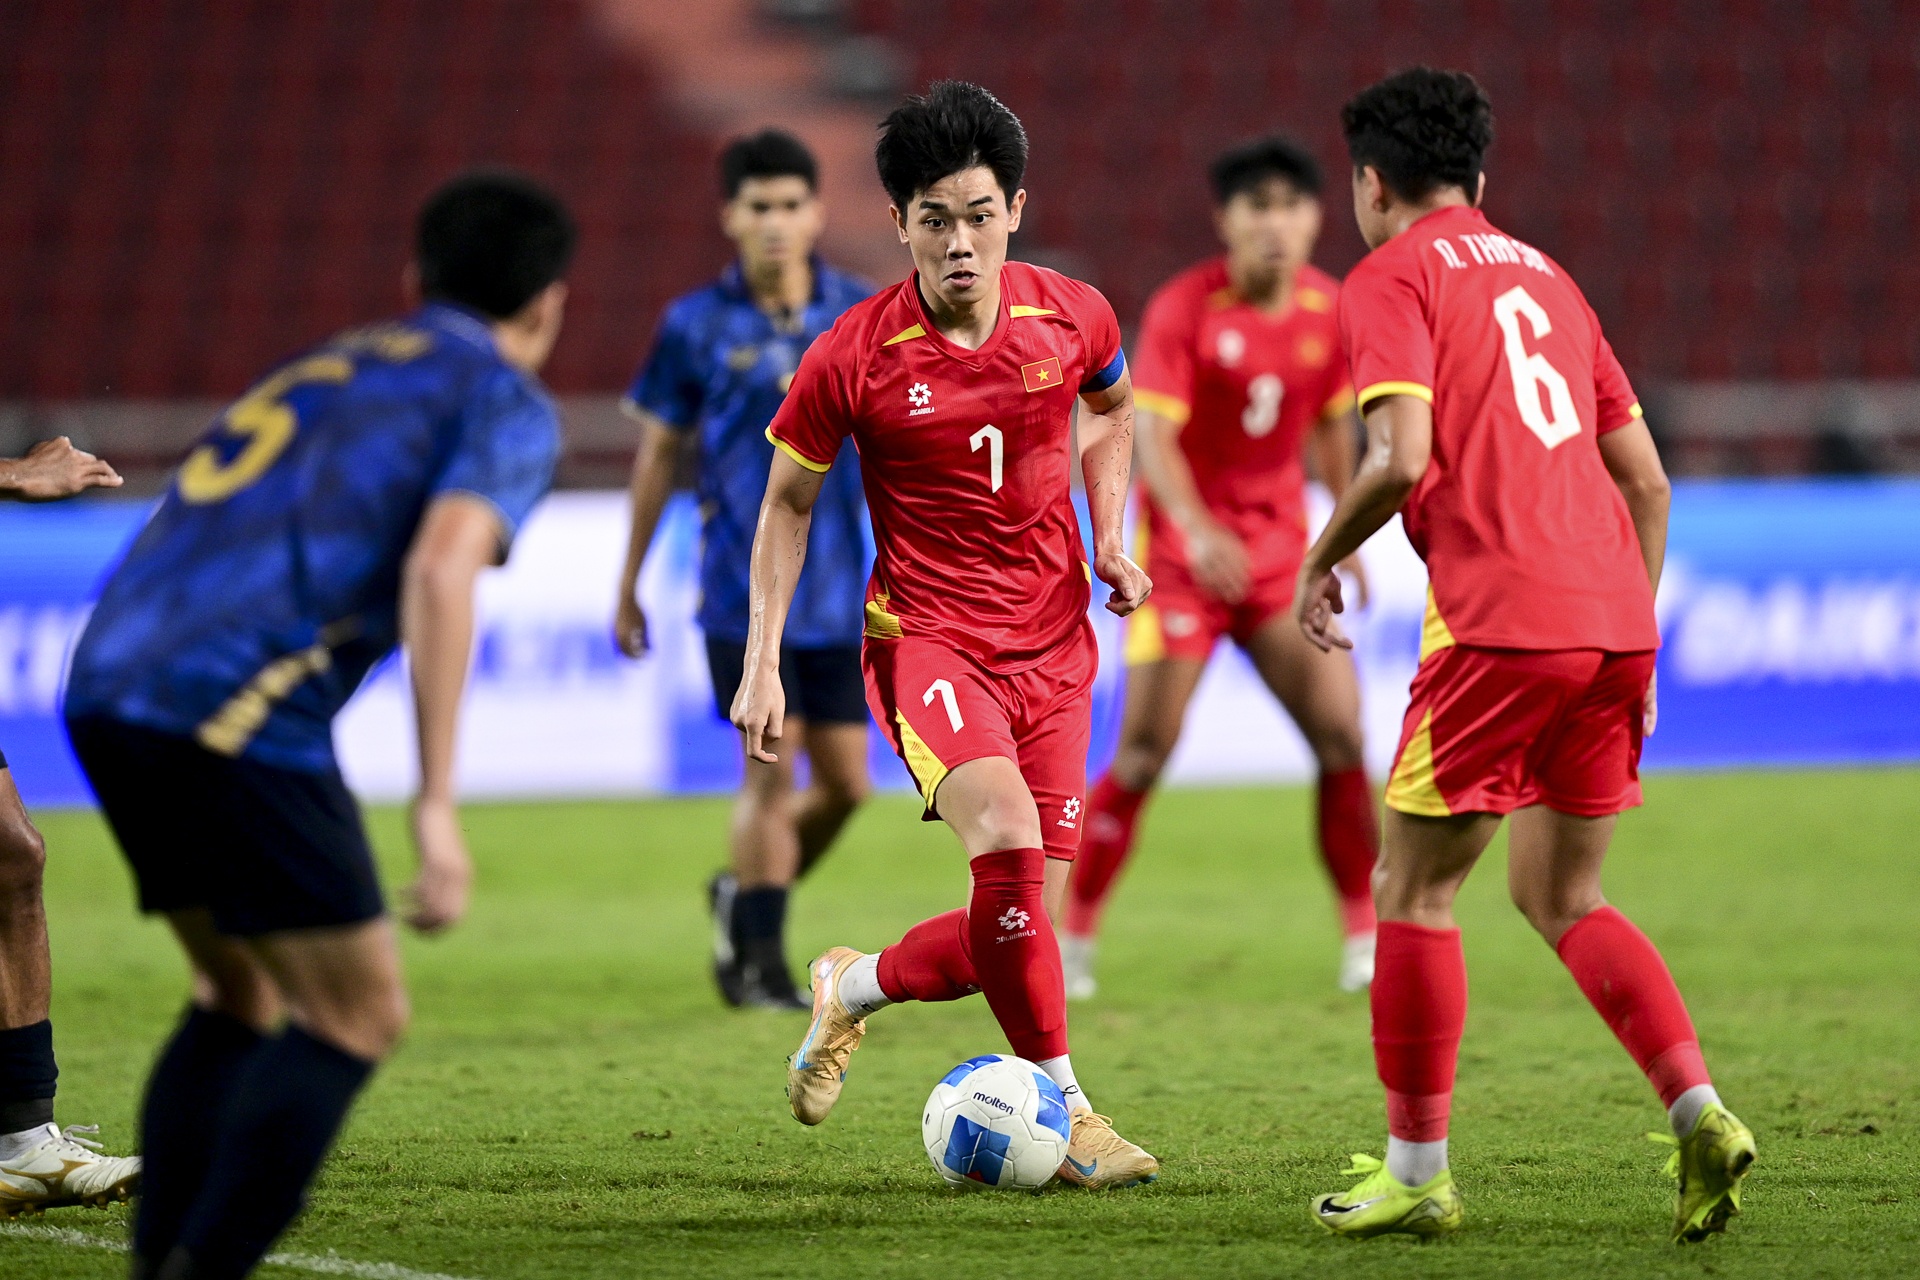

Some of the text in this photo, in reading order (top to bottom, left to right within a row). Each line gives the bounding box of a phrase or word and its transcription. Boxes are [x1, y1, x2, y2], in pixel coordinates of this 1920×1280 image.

[1493, 284, 1582, 451] 6
[178, 354, 354, 505] 5
[1241, 372, 1285, 439] 3
[969, 423, 1004, 494] 7
[922, 678, 965, 734] 7
[973, 1091, 1015, 1115] molten
